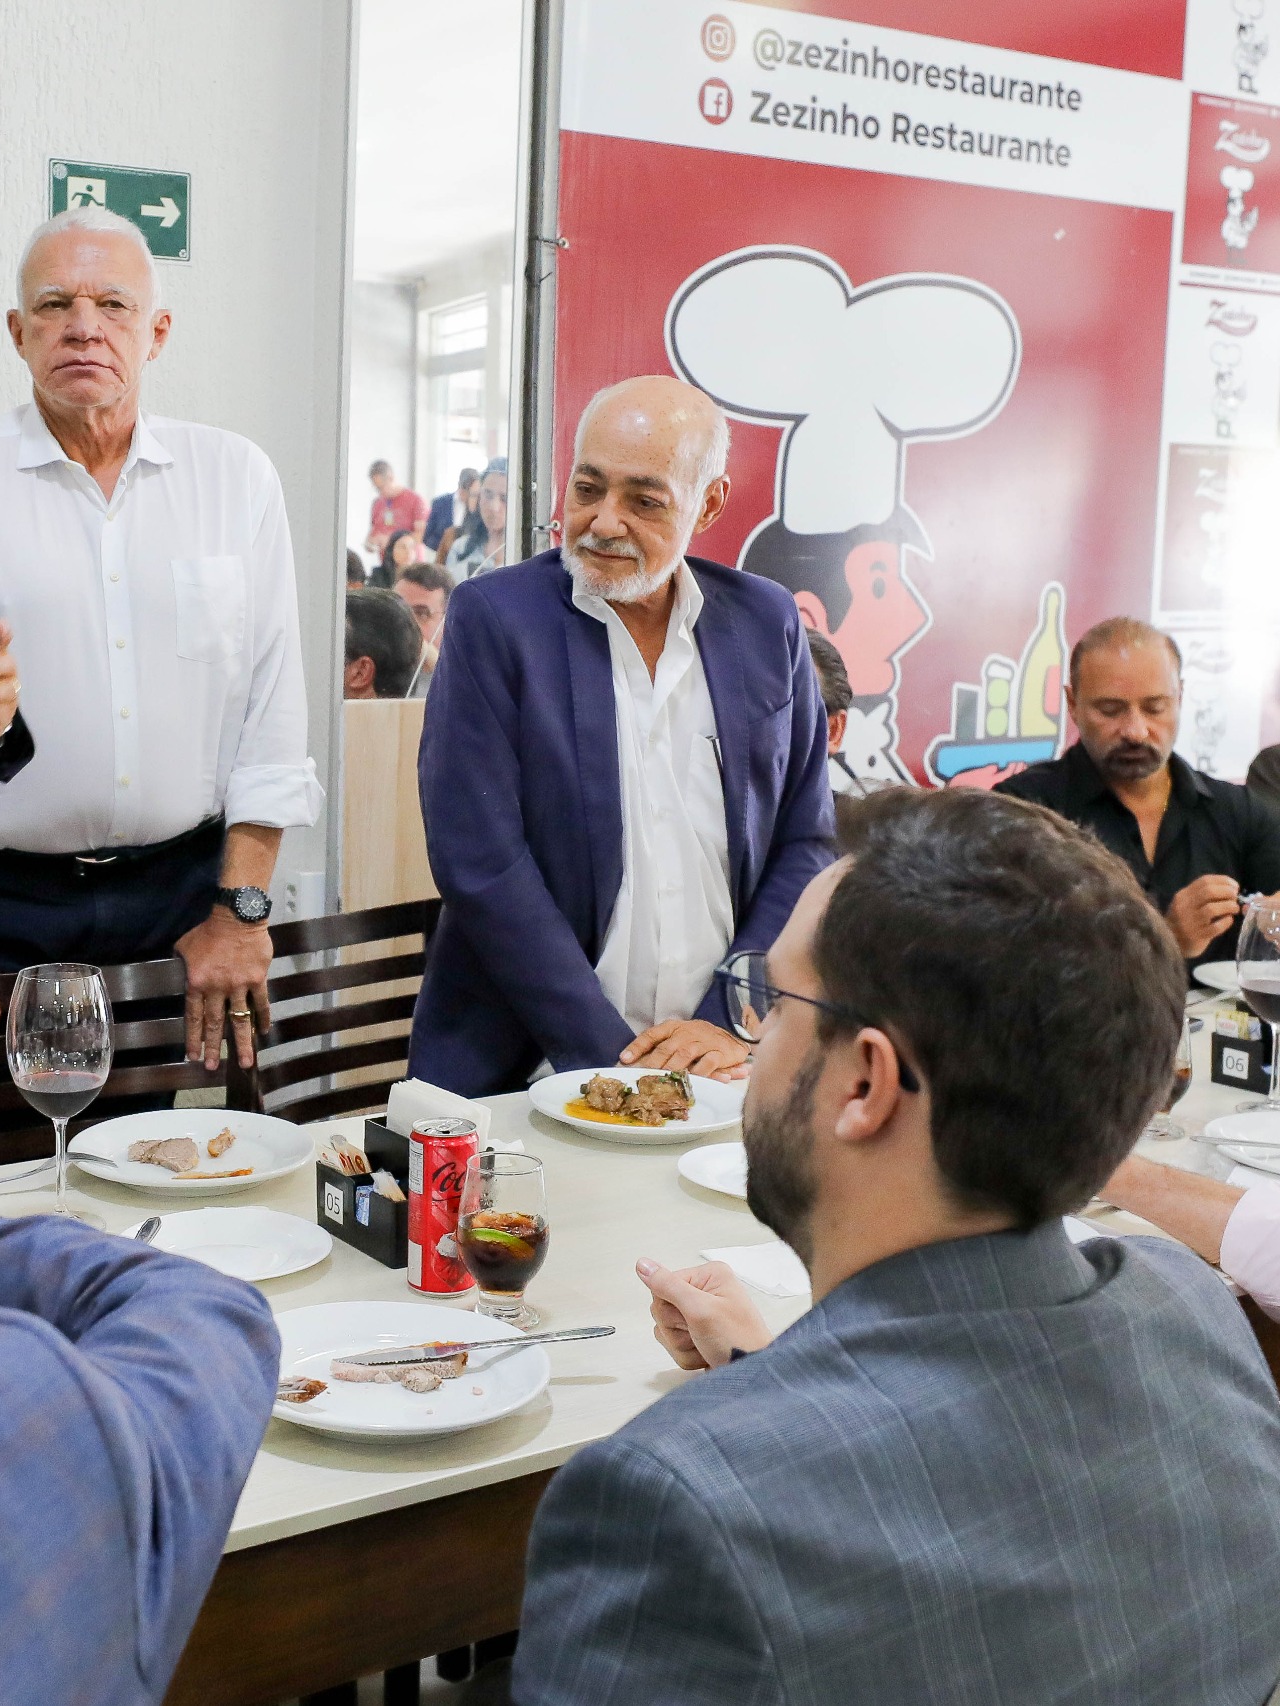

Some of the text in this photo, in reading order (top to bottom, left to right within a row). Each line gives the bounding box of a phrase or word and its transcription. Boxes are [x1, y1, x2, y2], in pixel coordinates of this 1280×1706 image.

[753, 28, 1082, 112] @zezinhorestaurante
[749, 90, 880, 139] Zezinho
[891, 112, 1071, 167] Restaurante
[1225, 1056, 1244, 1071] 06
[326, 1193, 340, 1215] 05
